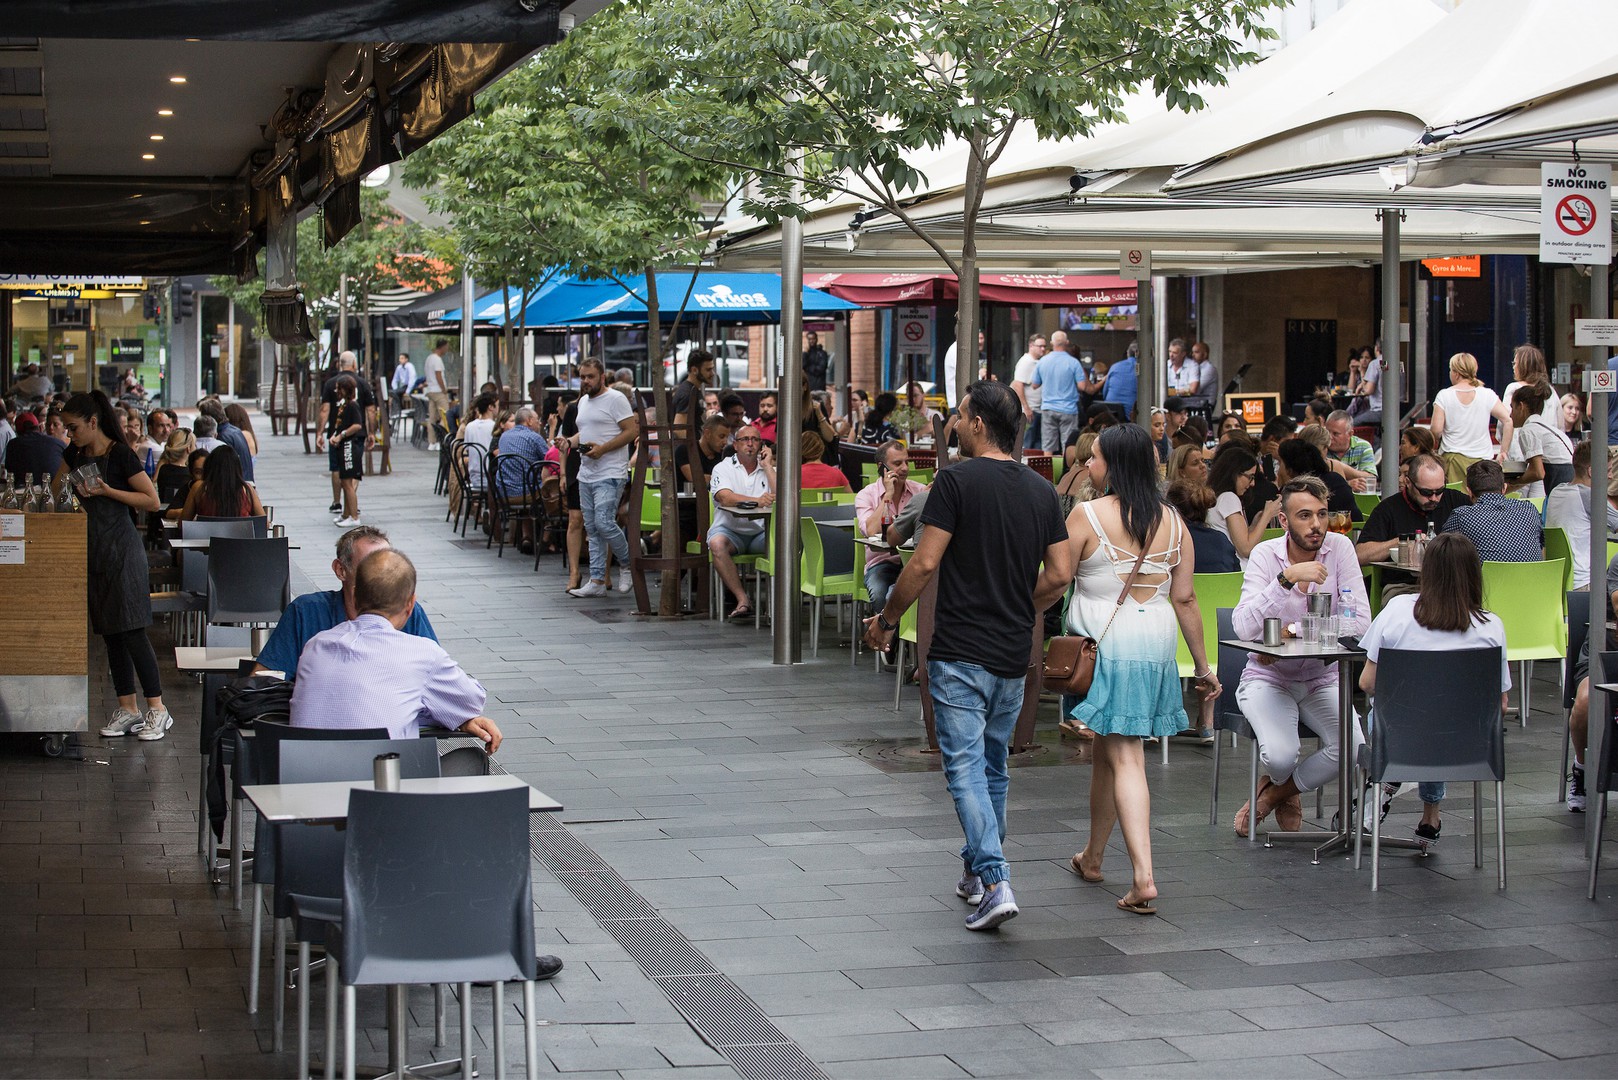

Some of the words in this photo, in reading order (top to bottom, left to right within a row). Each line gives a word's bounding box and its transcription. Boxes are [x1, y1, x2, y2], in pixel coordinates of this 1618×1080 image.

[1568, 168, 1587, 178] NO
[1546, 179, 1608, 190] SMOKING
[1432, 264, 1449, 274] Gyros
[1449, 264, 1456, 272] &
[693, 293, 767, 304] MYTHOS
[1076, 291, 1111, 303] Beraldo
[1242, 401, 1263, 417] Yefsi
